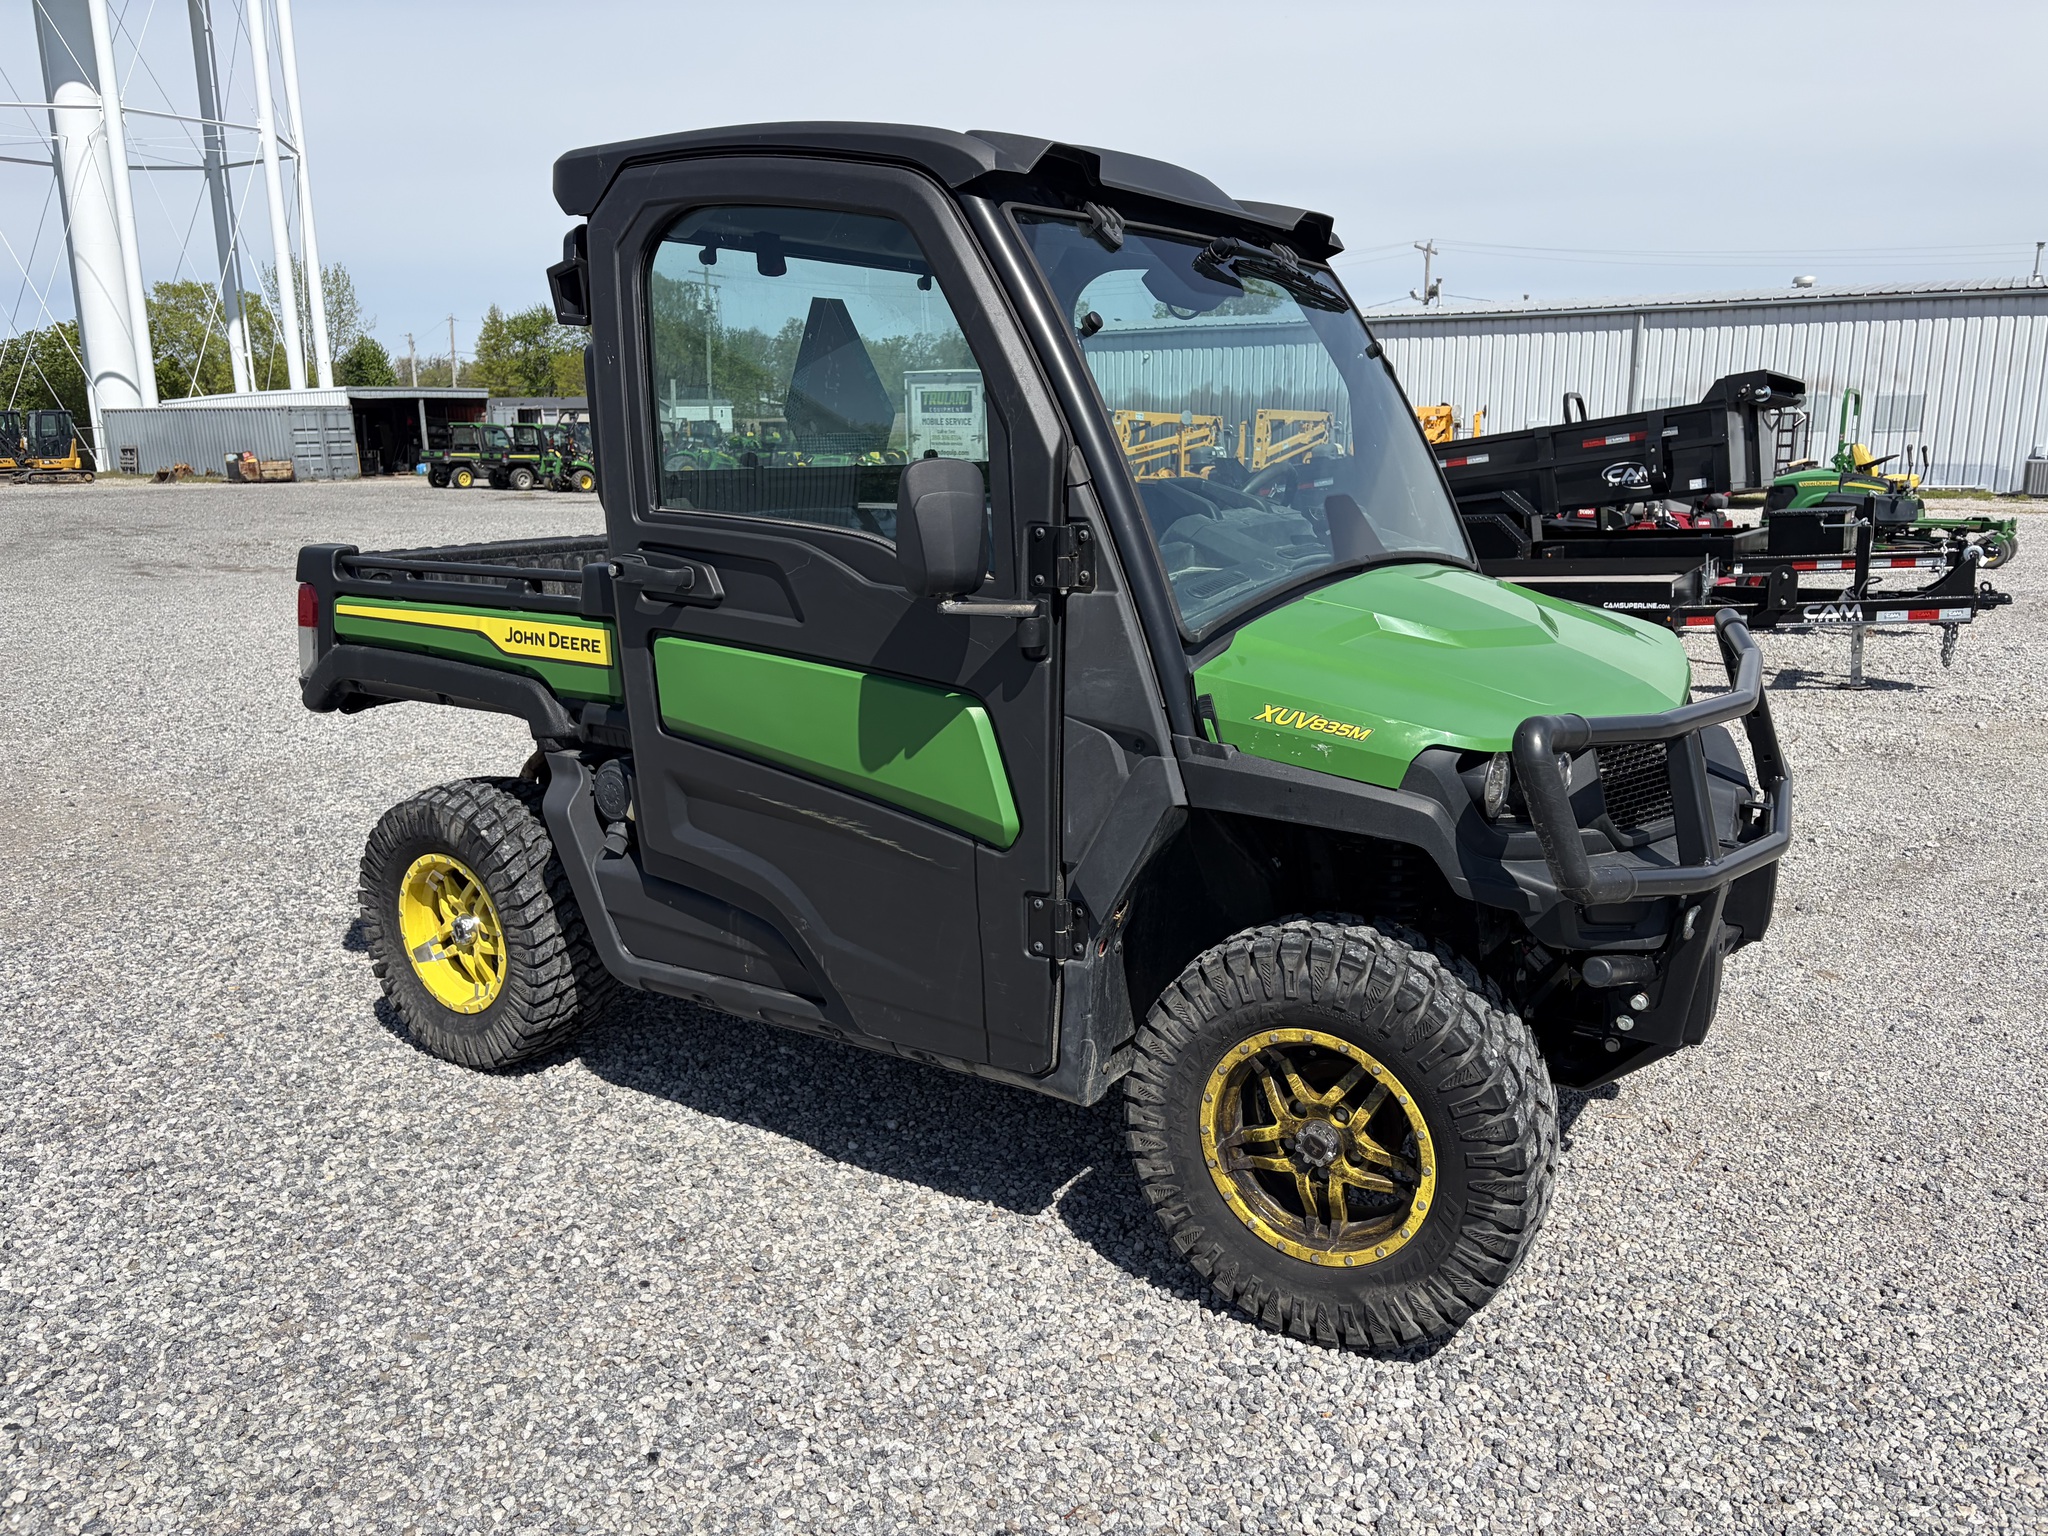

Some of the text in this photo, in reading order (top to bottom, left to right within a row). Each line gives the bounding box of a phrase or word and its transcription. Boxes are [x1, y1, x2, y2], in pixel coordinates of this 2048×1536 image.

[922, 391, 970, 405] TRULAND
[922, 417, 972, 426] MOBILE SERVICE
[1803, 603, 1863, 619] CAM
[505, 627, 601, 654] JOHN DEERE
[1250, 703, 1375, 742] XUV835M
